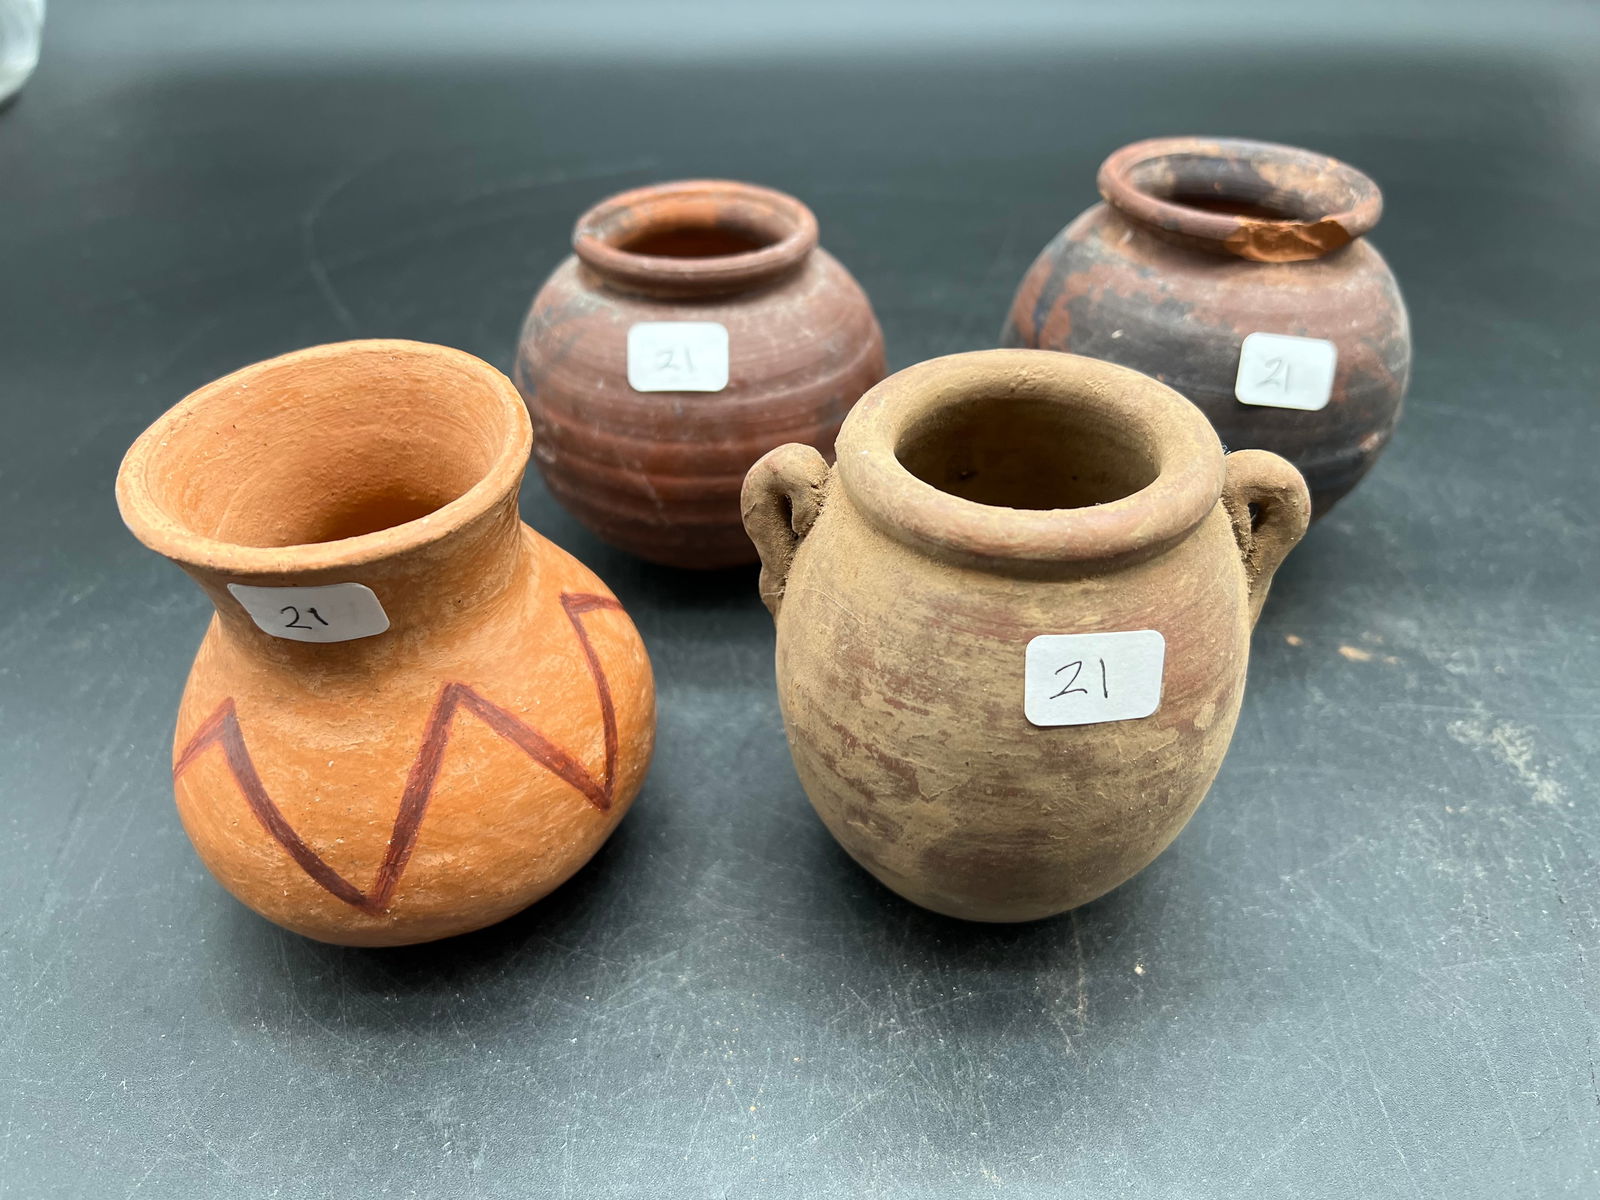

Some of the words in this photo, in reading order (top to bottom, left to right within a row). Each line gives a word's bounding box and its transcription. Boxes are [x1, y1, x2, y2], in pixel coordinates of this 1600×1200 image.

[655, 346, 695, 374] 21
[1255, 356, 1290, 393] 21
[280, 605, 329, 630] 21
[1048, 658, 1109, 700] 21
